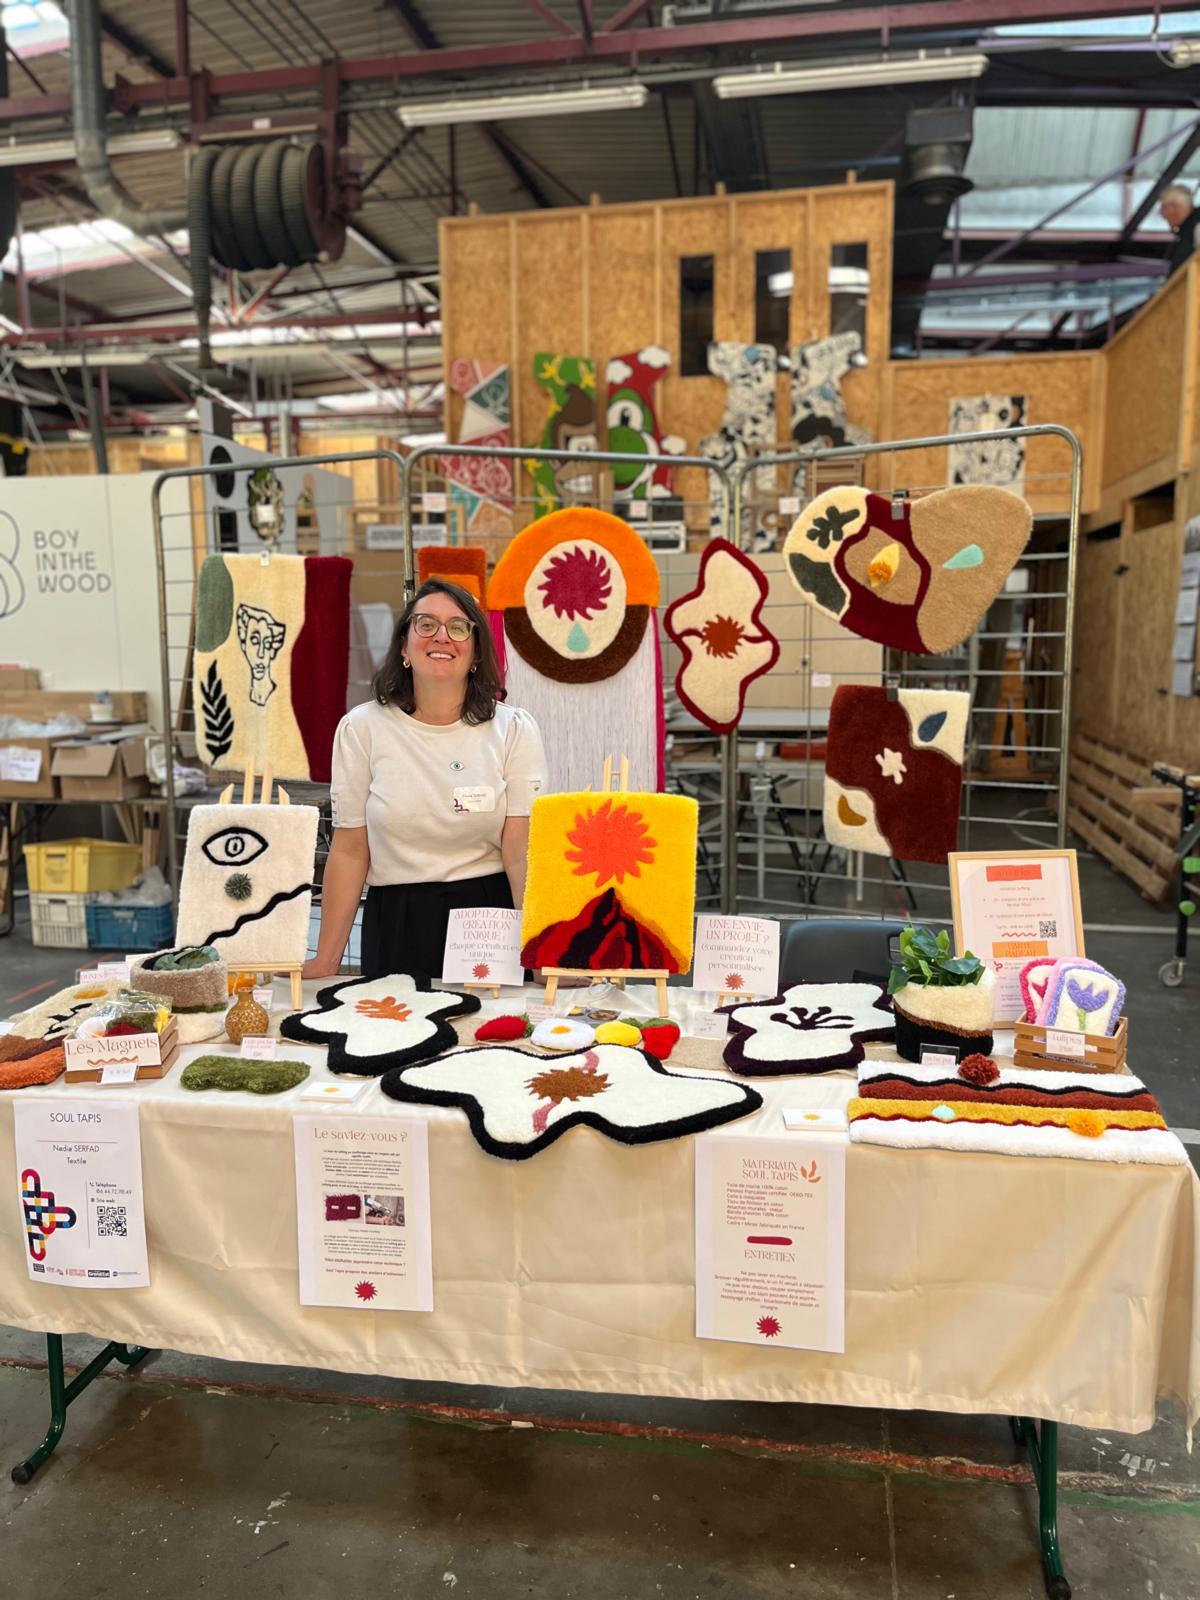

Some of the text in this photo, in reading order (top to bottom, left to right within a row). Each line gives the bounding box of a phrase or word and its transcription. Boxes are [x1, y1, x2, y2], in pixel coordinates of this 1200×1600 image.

[33, 529, 79, 550] BOY
[38, 573, 112, 594] WOOD
[454, 910, 498, 919] ADOPTEZ
[709, 919, 730, 929] UNE
[464, 930, 500, 942] UNIQUE
[706, 930, 720, 940] UN
[723, 931, 760, 943] PROJET
[66, 1036, 158, 1055] Les Magnets
[49, 1112, 102, 1123] SOUL TAPIS
[314, 1127, 329, 1139] Le
[400, 1131, 408, 1142] ?
[52, 1144, 72, 1152] Nadia
[67, 1155, 87, 1164] Textile
[742, 1159, 798, 1171] MATERIAUX
[742, 1169, 799, 1181] SOUL TAPIS
[744, 1249, 796, 1262] ENTRETIEN
